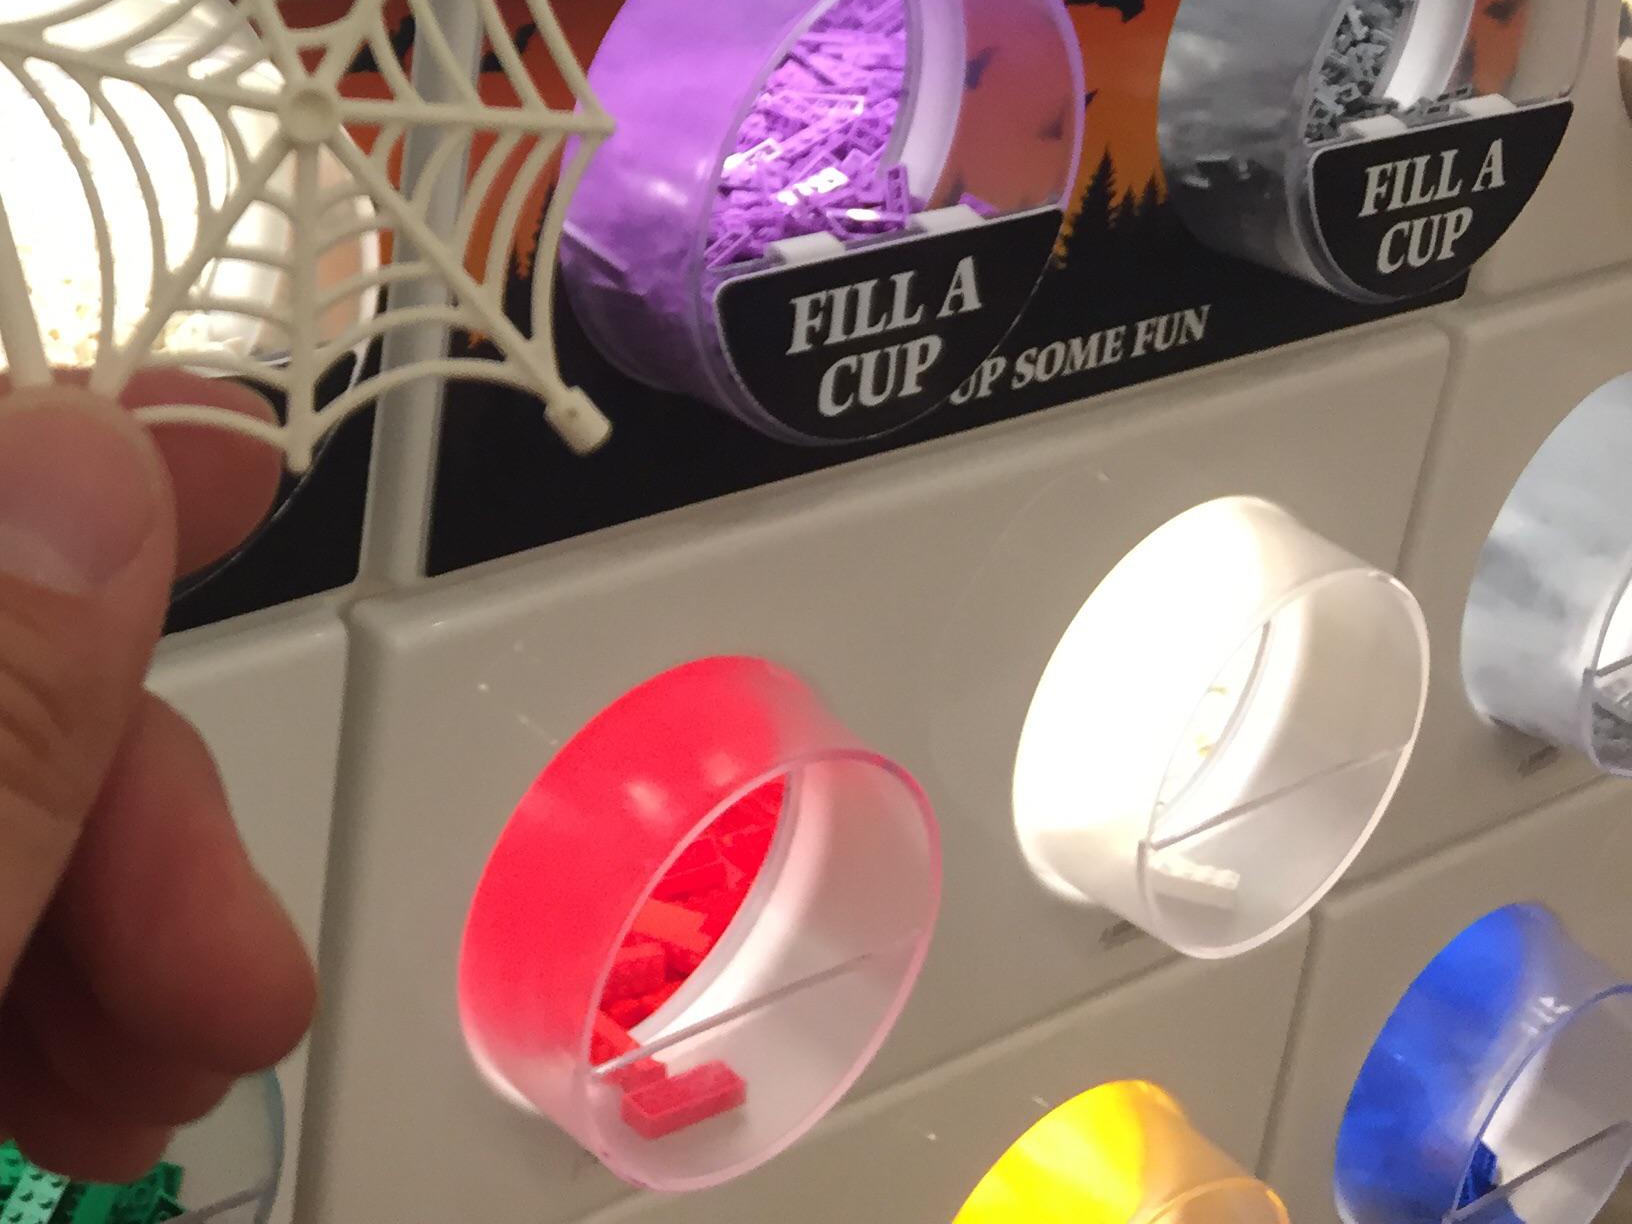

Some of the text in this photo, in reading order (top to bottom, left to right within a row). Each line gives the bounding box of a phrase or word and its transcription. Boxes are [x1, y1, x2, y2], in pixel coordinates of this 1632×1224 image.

[1358, 137, 1507, 218] FILL A
[1376, 206, 1474, 274] CUP
[785, 255, 983, 356] FILL A
[1011, 323, 1126, 389] SOME
[1129, 304, 1213, 357] FUN
[817, 334, 944, 418] CUP
